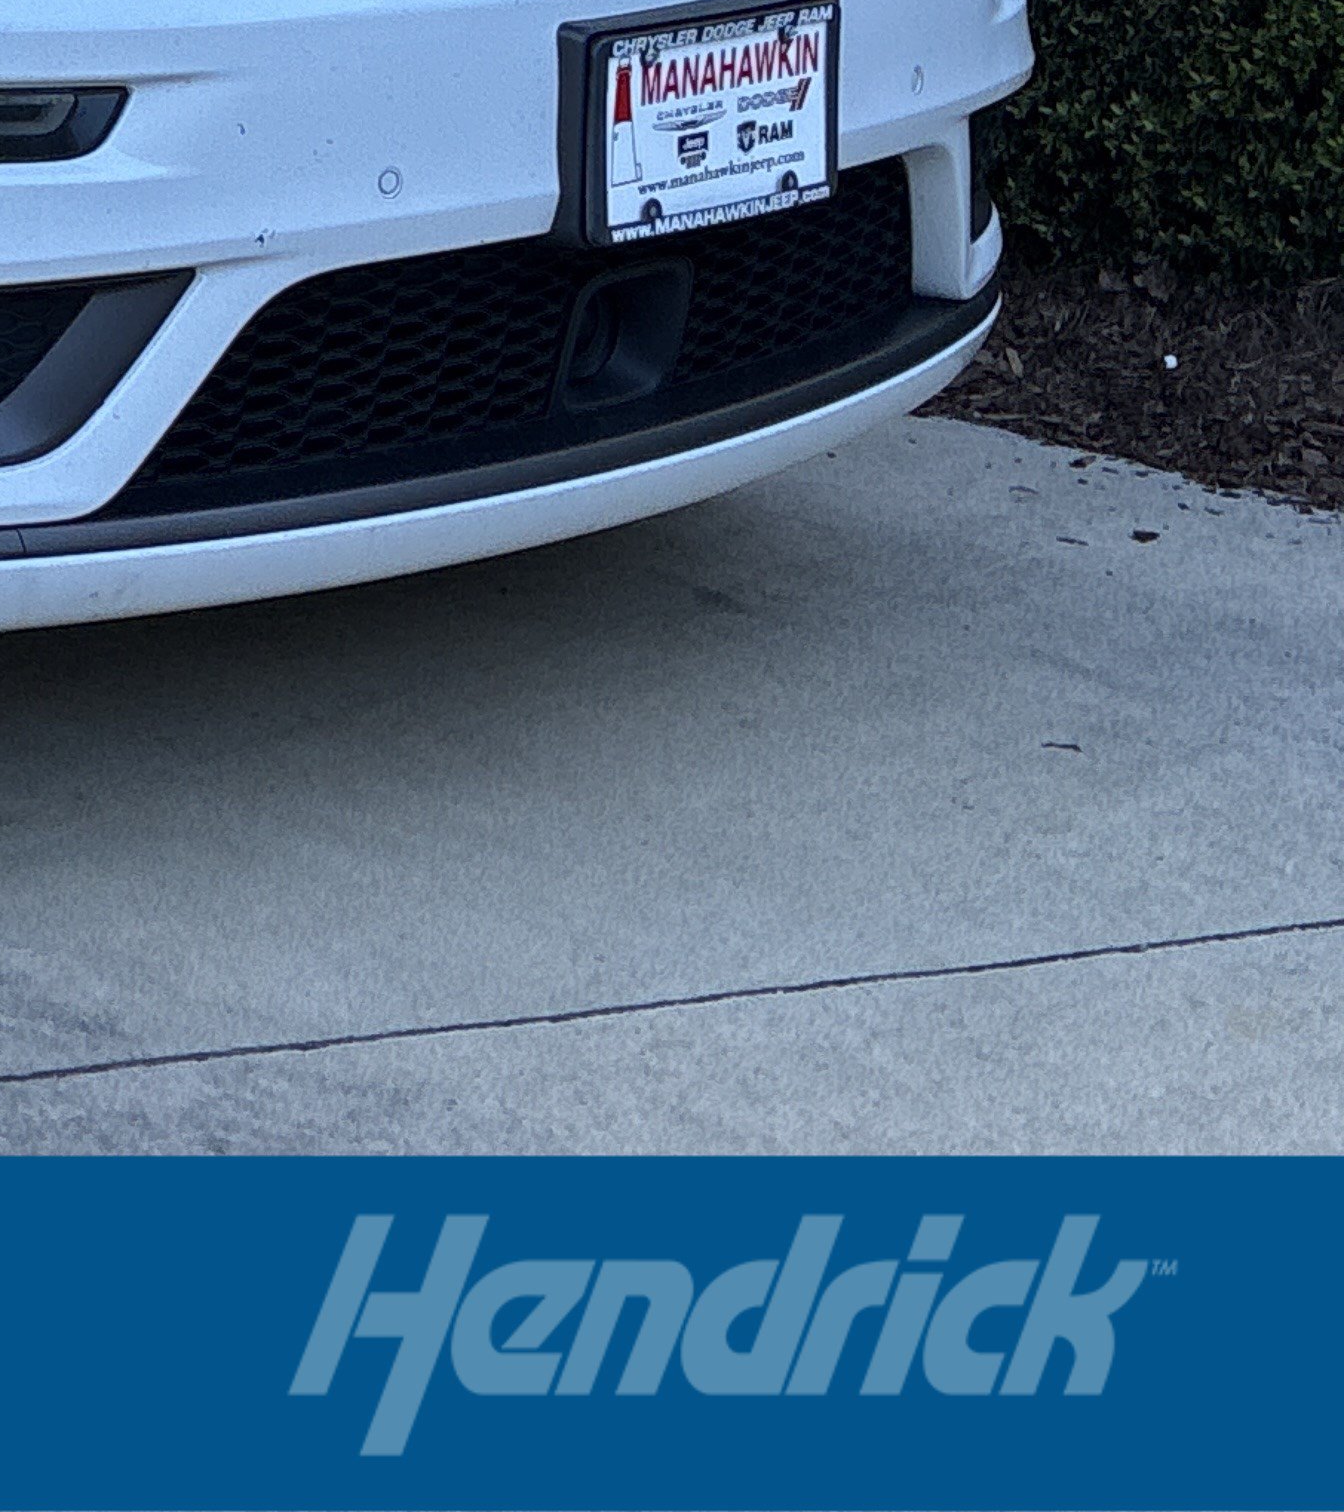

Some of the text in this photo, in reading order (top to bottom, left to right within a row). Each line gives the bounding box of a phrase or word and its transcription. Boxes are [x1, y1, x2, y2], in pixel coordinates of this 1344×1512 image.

[612, 4, 834, 58] CHRYSLER DODGE JEEP RAM
[640, 30, 820, 107] MANAHAWKIN
[737, 86, 801, 113] DODGE
[758, 120, 794, 145] RAM
[637, 151, 806, 196] www.manahawkinjeep.com
[611, 186, 831, 243] www.MANAHAWKINJEEP.com
